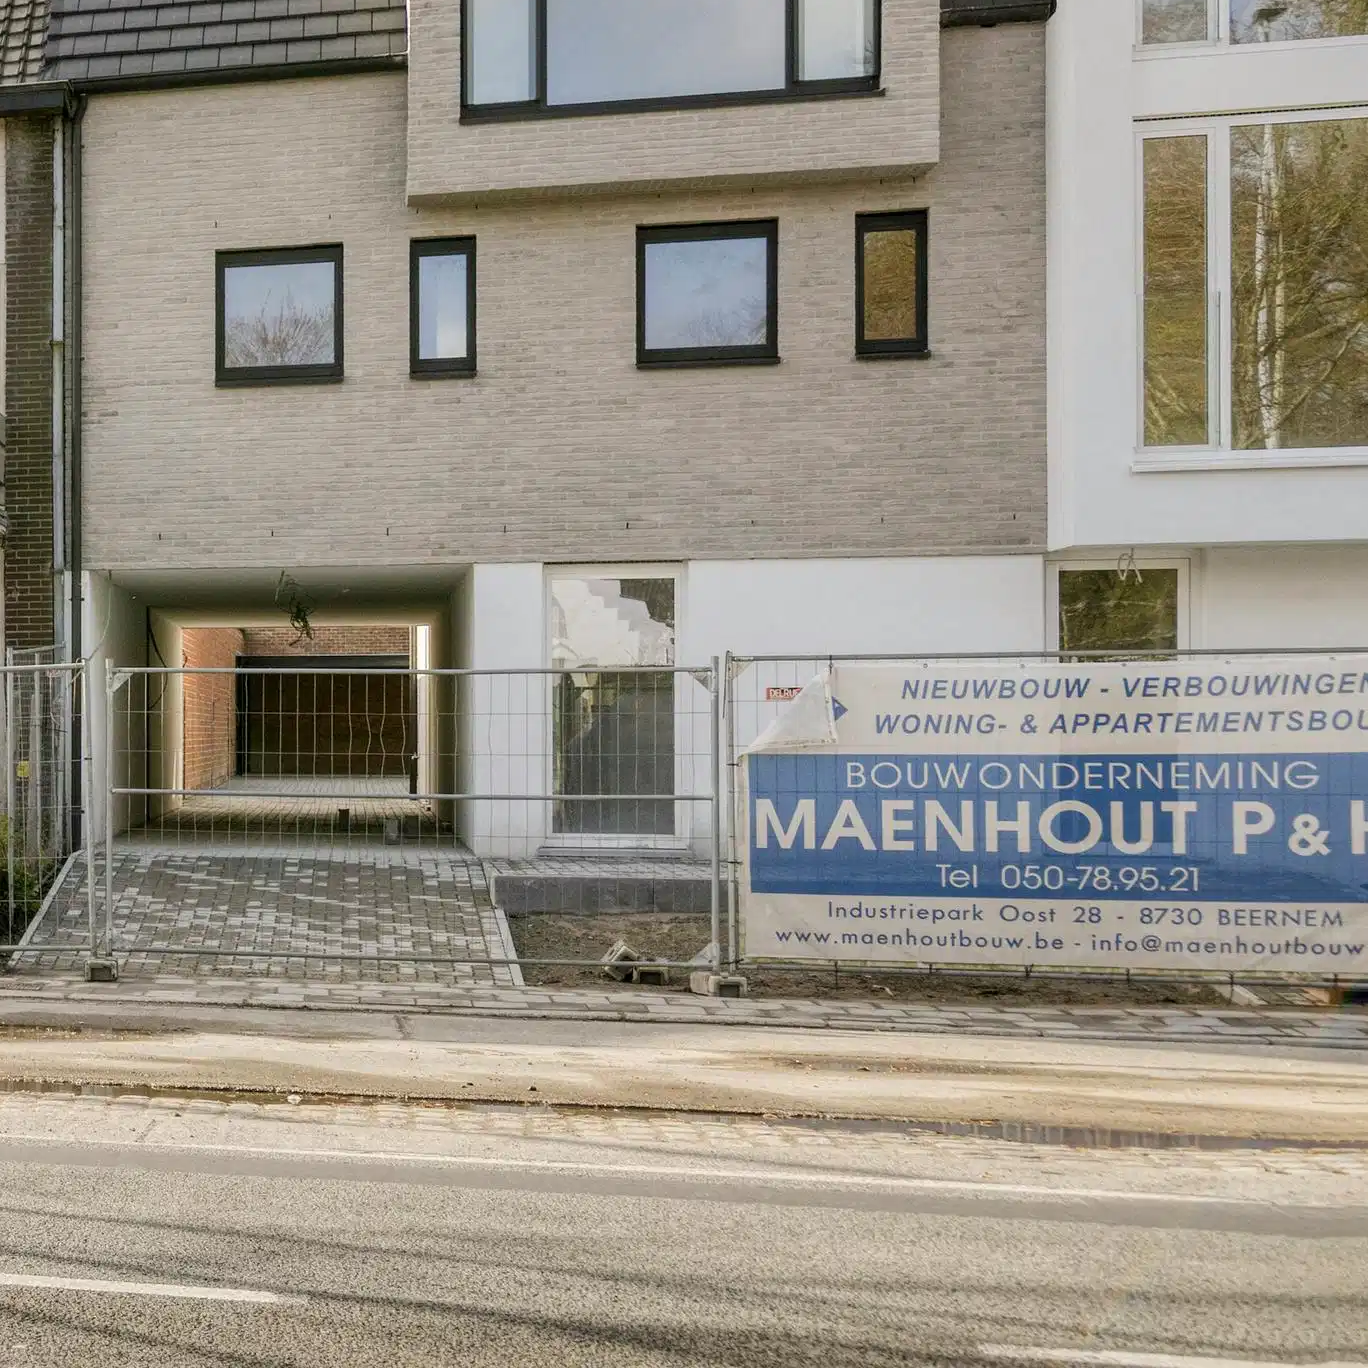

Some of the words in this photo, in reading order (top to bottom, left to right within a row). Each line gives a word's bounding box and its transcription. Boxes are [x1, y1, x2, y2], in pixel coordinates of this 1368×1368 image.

[769, 687, 799, 699] DELRU
[901, 678, 1091, 699] NIEUWBOUW
[875, 714, 1007, 734] WONING-
[1020, 714, 1038, 734] &
[846, 761, 1320, 790] BOUWONDERNEMING
[755, 798, 1198, 855] MAENHOUT
[1232, 800, 1276, 855] P
[1288, 813, 1332, 857] &
[935, 864, 978, 888] Tel
[1001, 864, 1200, 892] 050-78.95.21
[828, 901, 984, 924] Industriepark
[999, 904, 1056, 923] Oost
[1072, 907, 1102, 924] 28
[1140, 908, 1203, 926] 8730
[1218, 909, 1343, 928] BEERNEM
[775, 928, 1064, 951] www.maenhoutbouw.be
